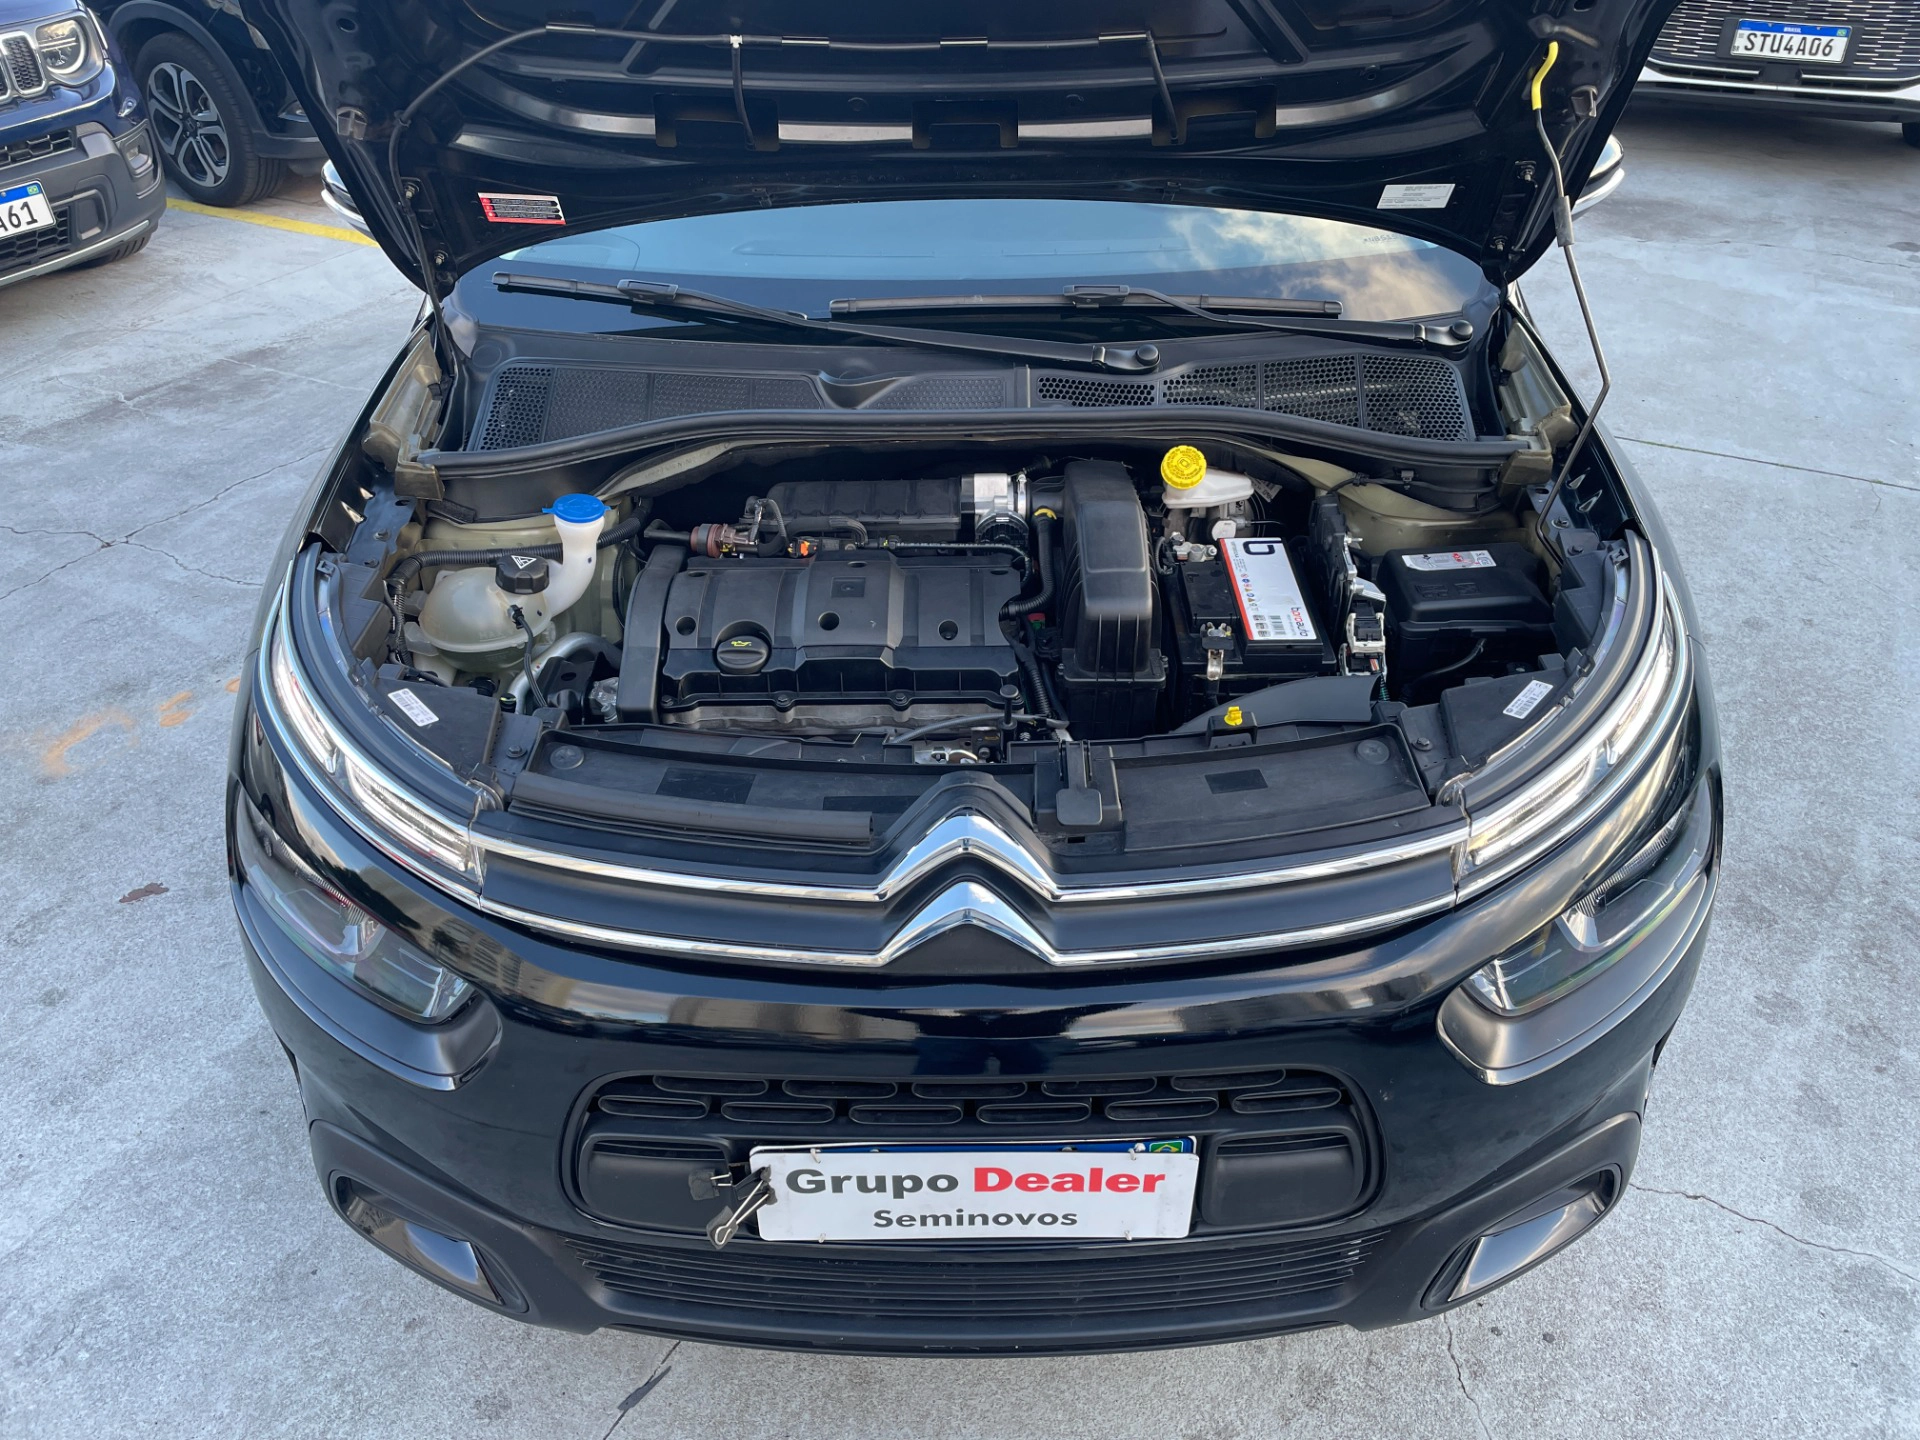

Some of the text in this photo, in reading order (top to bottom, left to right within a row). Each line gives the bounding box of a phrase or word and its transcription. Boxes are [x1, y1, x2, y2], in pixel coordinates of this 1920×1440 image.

[1744, 33, 1835, 57] STU4A06
[785, 1166, 1166, 1200] Grupo Dealer
[873, 1208, 1078, 1228] Seminovos
